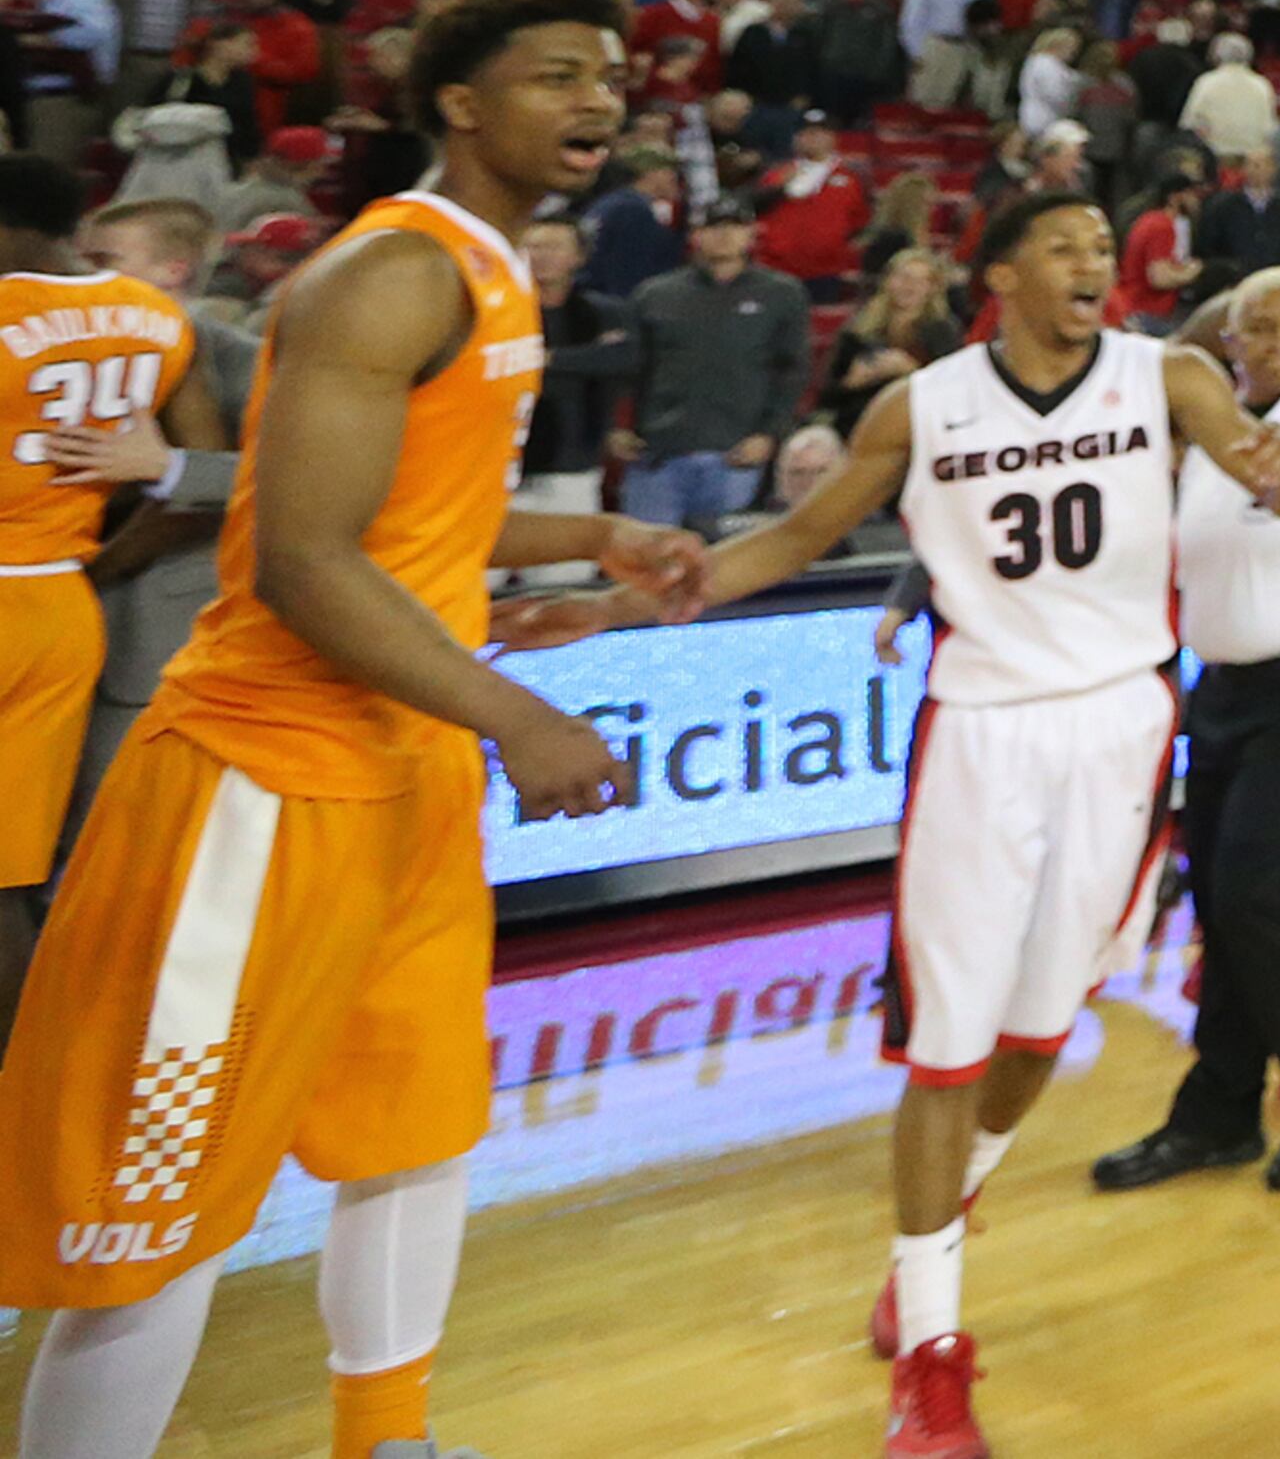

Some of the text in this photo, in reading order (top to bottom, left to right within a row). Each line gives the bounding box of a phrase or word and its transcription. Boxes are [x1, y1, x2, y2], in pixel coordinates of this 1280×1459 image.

[932, 426, 1149, 481] GEORGIA
[988, 481, 1103, 580] 30
[58, 1211, 200, 1265] VOLS
